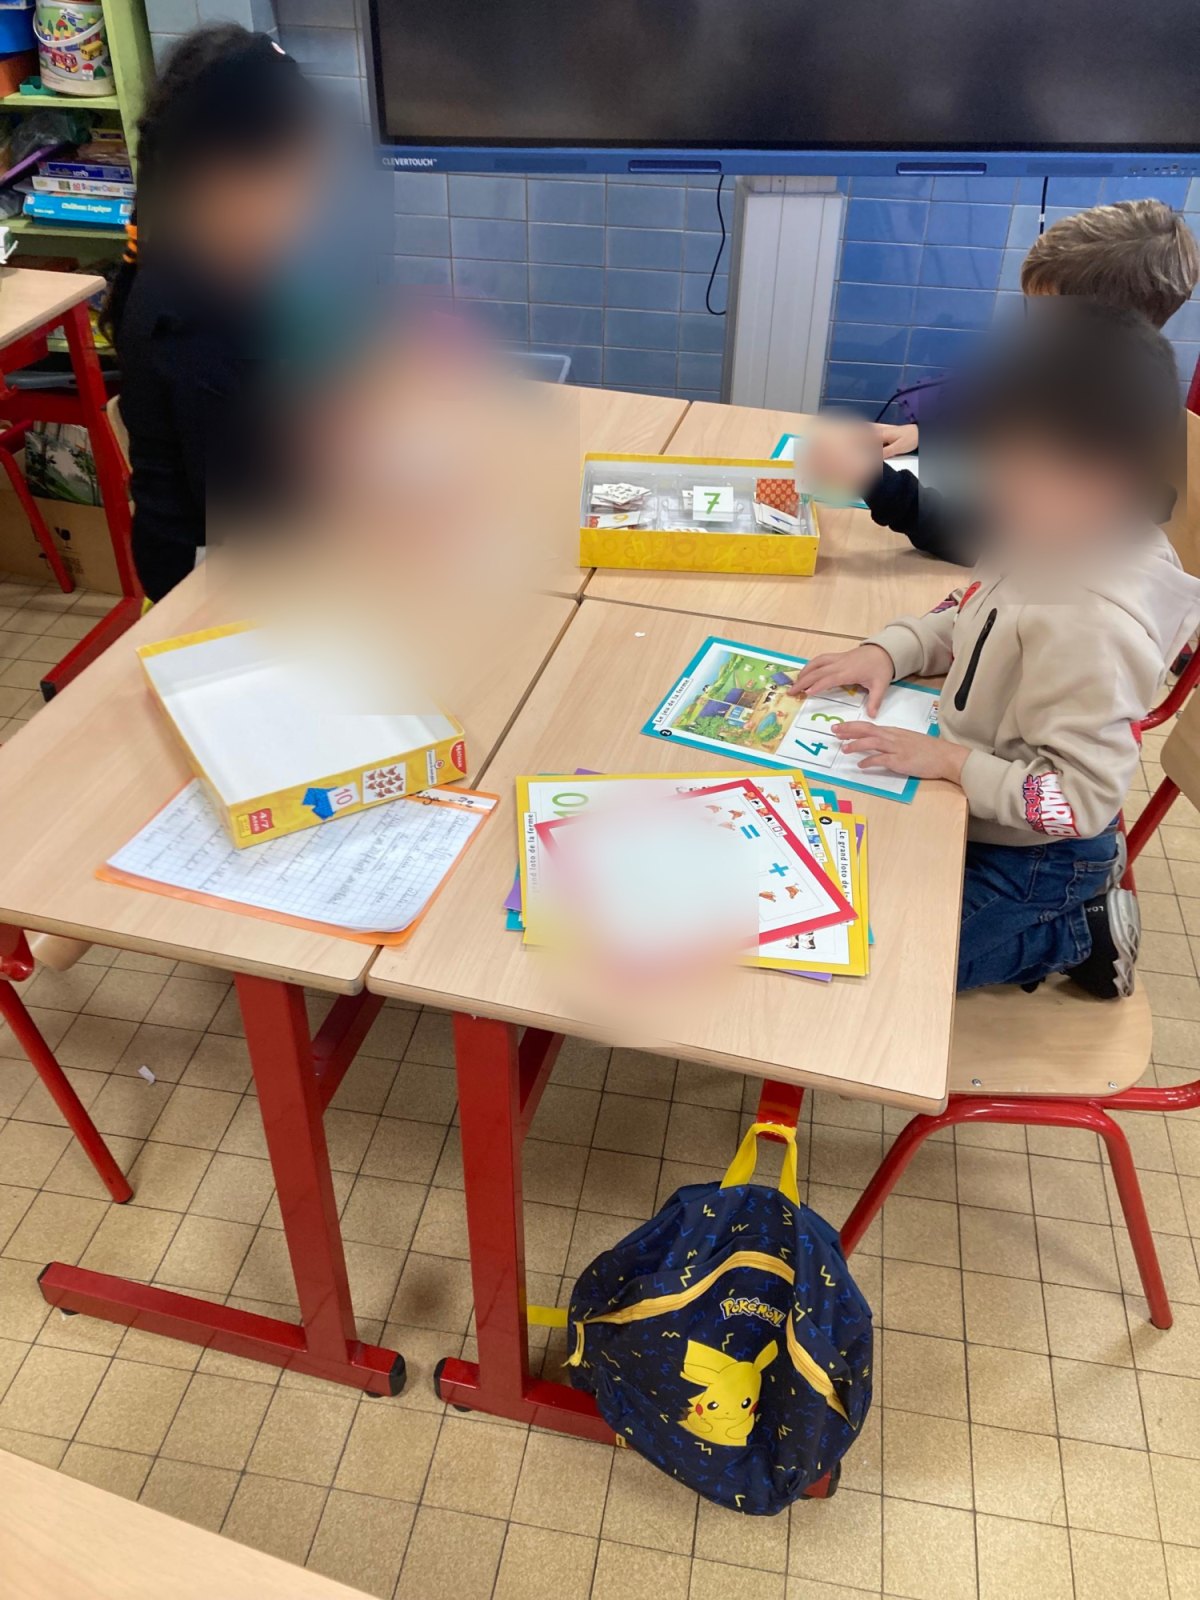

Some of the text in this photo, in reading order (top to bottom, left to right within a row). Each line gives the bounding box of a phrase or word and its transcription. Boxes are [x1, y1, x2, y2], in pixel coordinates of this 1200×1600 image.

[703, 492, 721, 515] 7
[811, 712, 845, 725] 3
[794, 736, 829, 756] 4
[455, 744, 463, 768] NATHAN
[334, 788, 353, 805] 10
[527, 814, 535, 834] ferme
[839, 831, 847, 839] Le
[528, 845, 536, 854] de
[838, 841, 849, 861] grand
[529, 855, 537, 870] loto
[840, 863, 849, 878] loto
[841, 880, 849, 889] de
